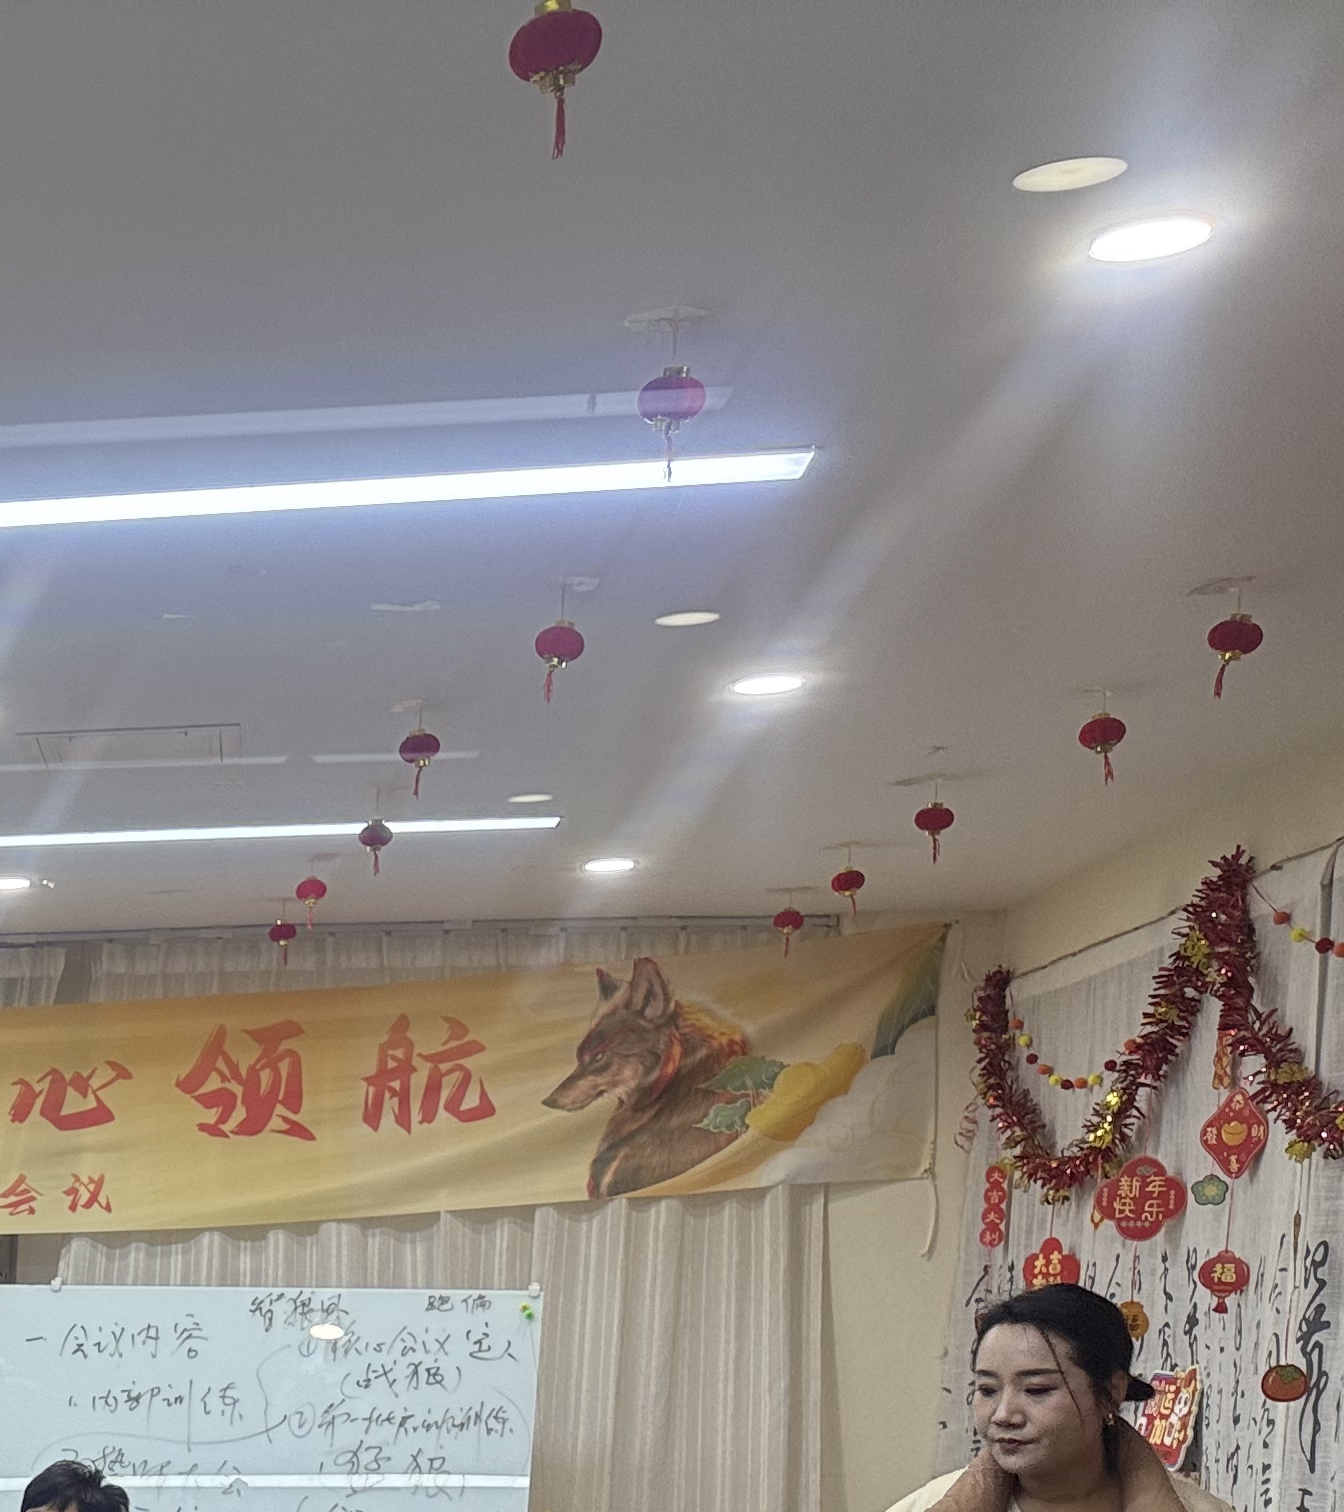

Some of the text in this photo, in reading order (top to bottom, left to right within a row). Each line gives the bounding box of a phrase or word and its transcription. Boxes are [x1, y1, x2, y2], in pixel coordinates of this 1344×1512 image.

[1116, 1174, 1168, 1198] 新年
[982, 1169, 1005, 1248] 大吉大利
[1112, 1196, 1166, 1222] 快乐
[1211, 1262, 1237, 1283] 福
